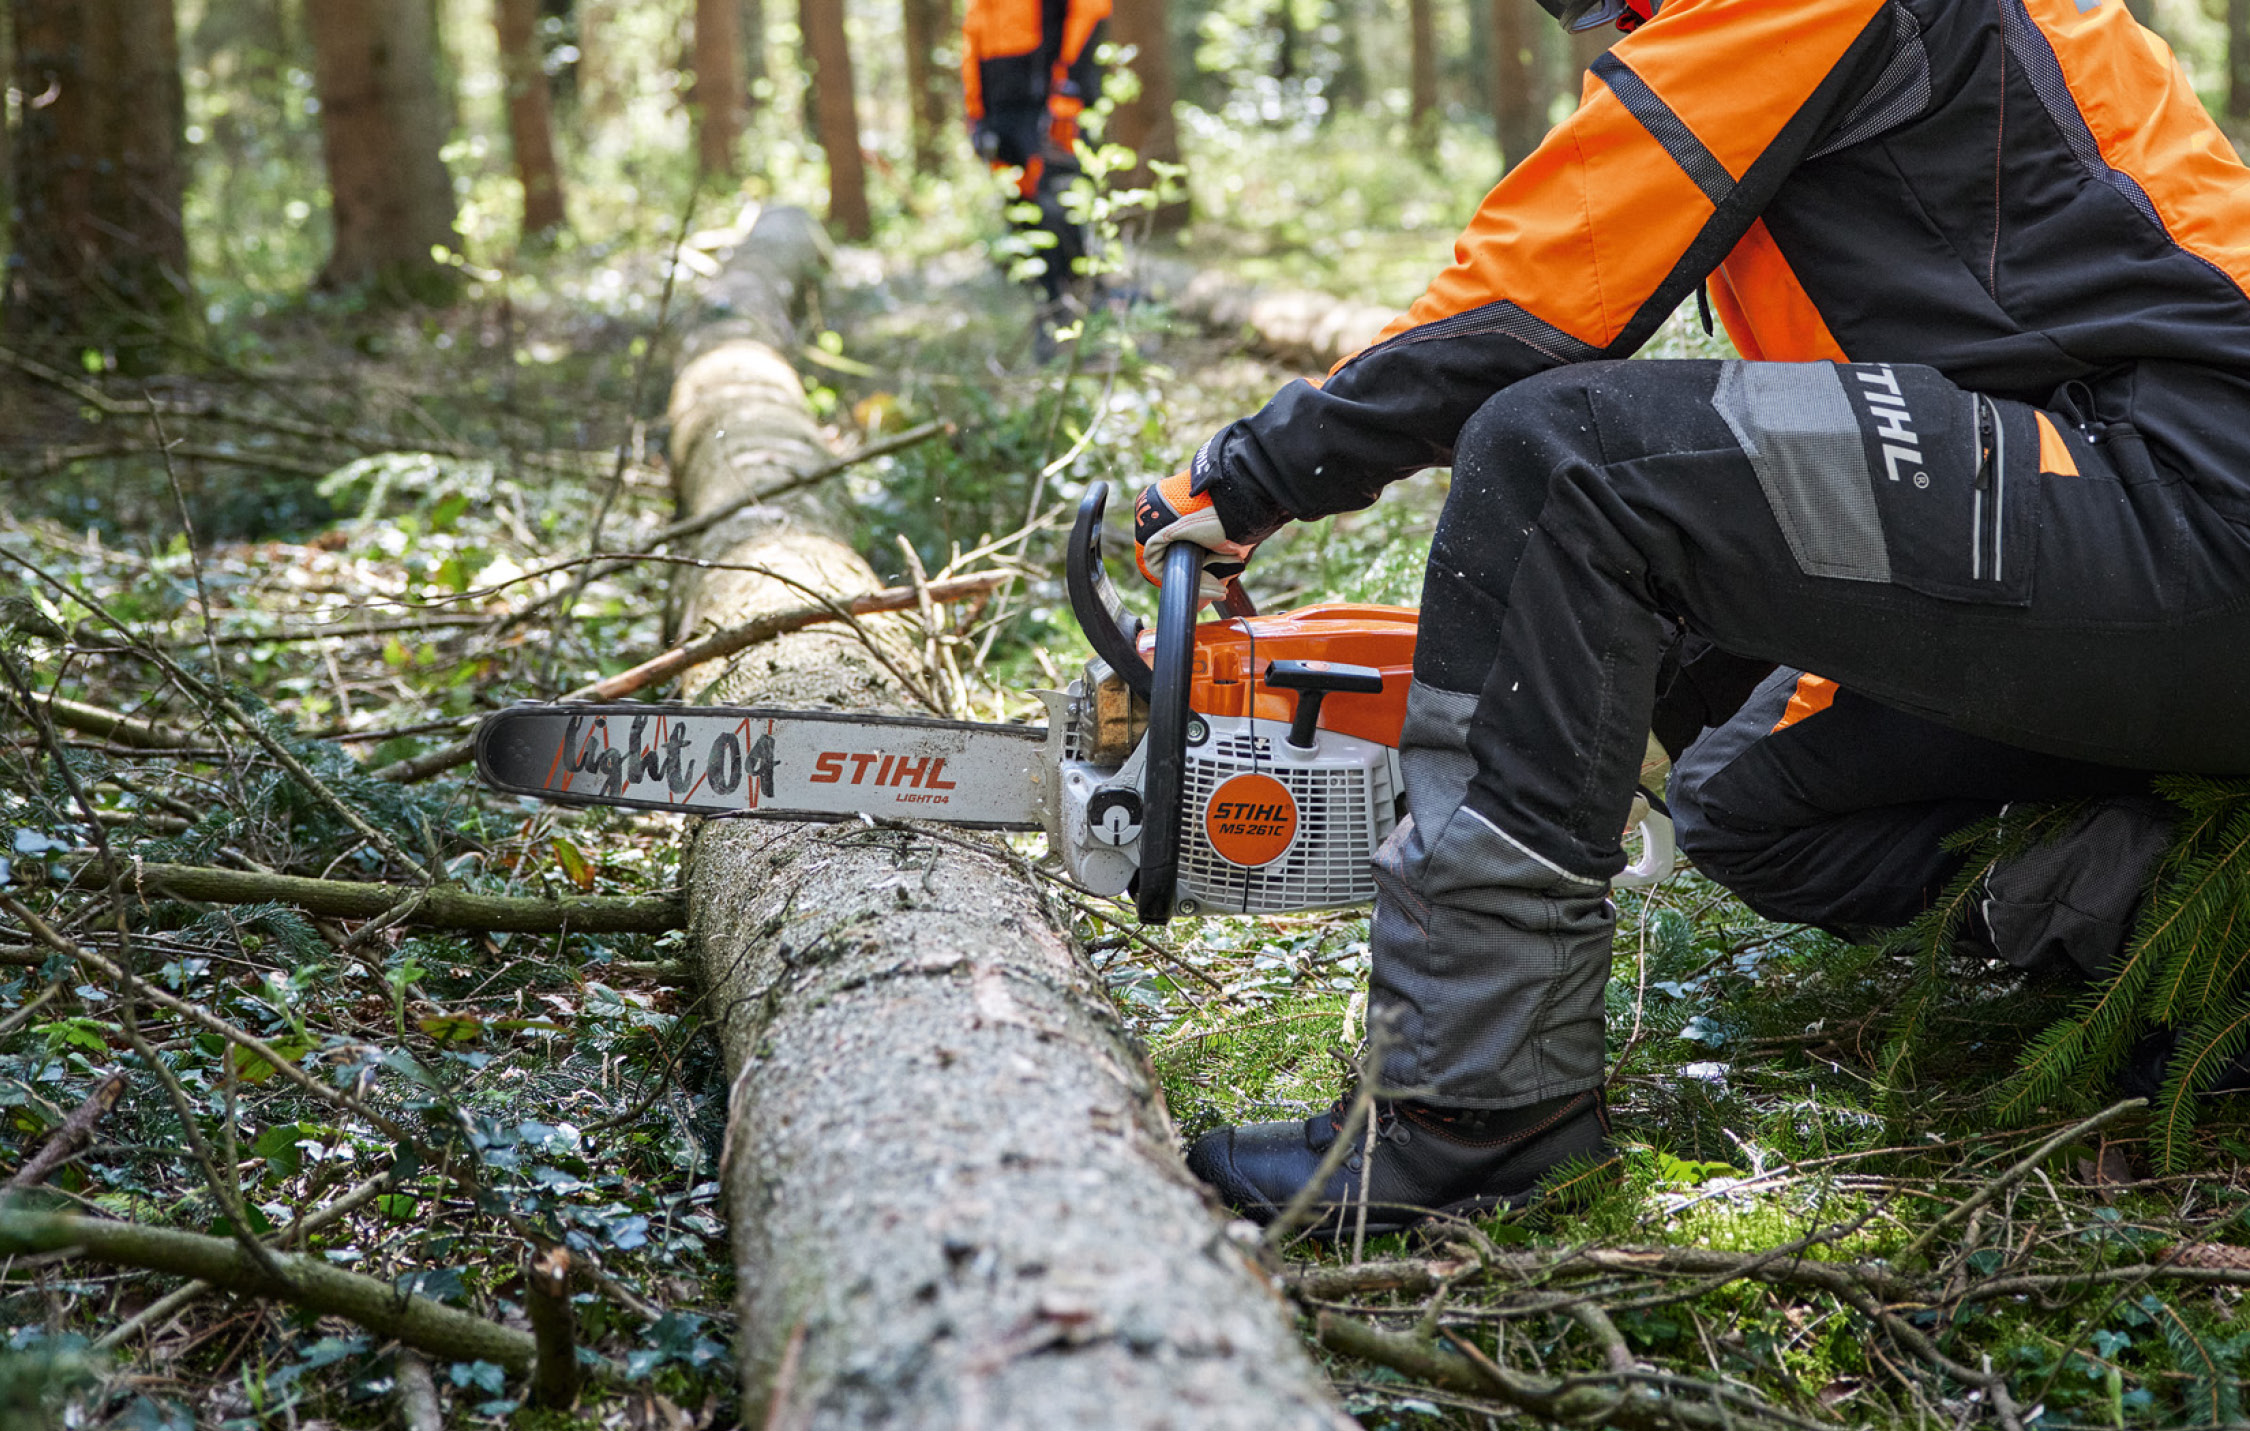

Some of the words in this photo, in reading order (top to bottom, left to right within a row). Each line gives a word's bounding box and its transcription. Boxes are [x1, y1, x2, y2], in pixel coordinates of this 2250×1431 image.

[1856, 363, 1923, 481] TIHL
[563, 716, 696, 797] light
[707, 732, 781, 798] 04
[809, 752, 957, 790] STIHL
[1213, 802, 1289, 822] STIHL
[1219, 823, 1246, 835] MS
[1246, 824, 1285, 837] 261C
